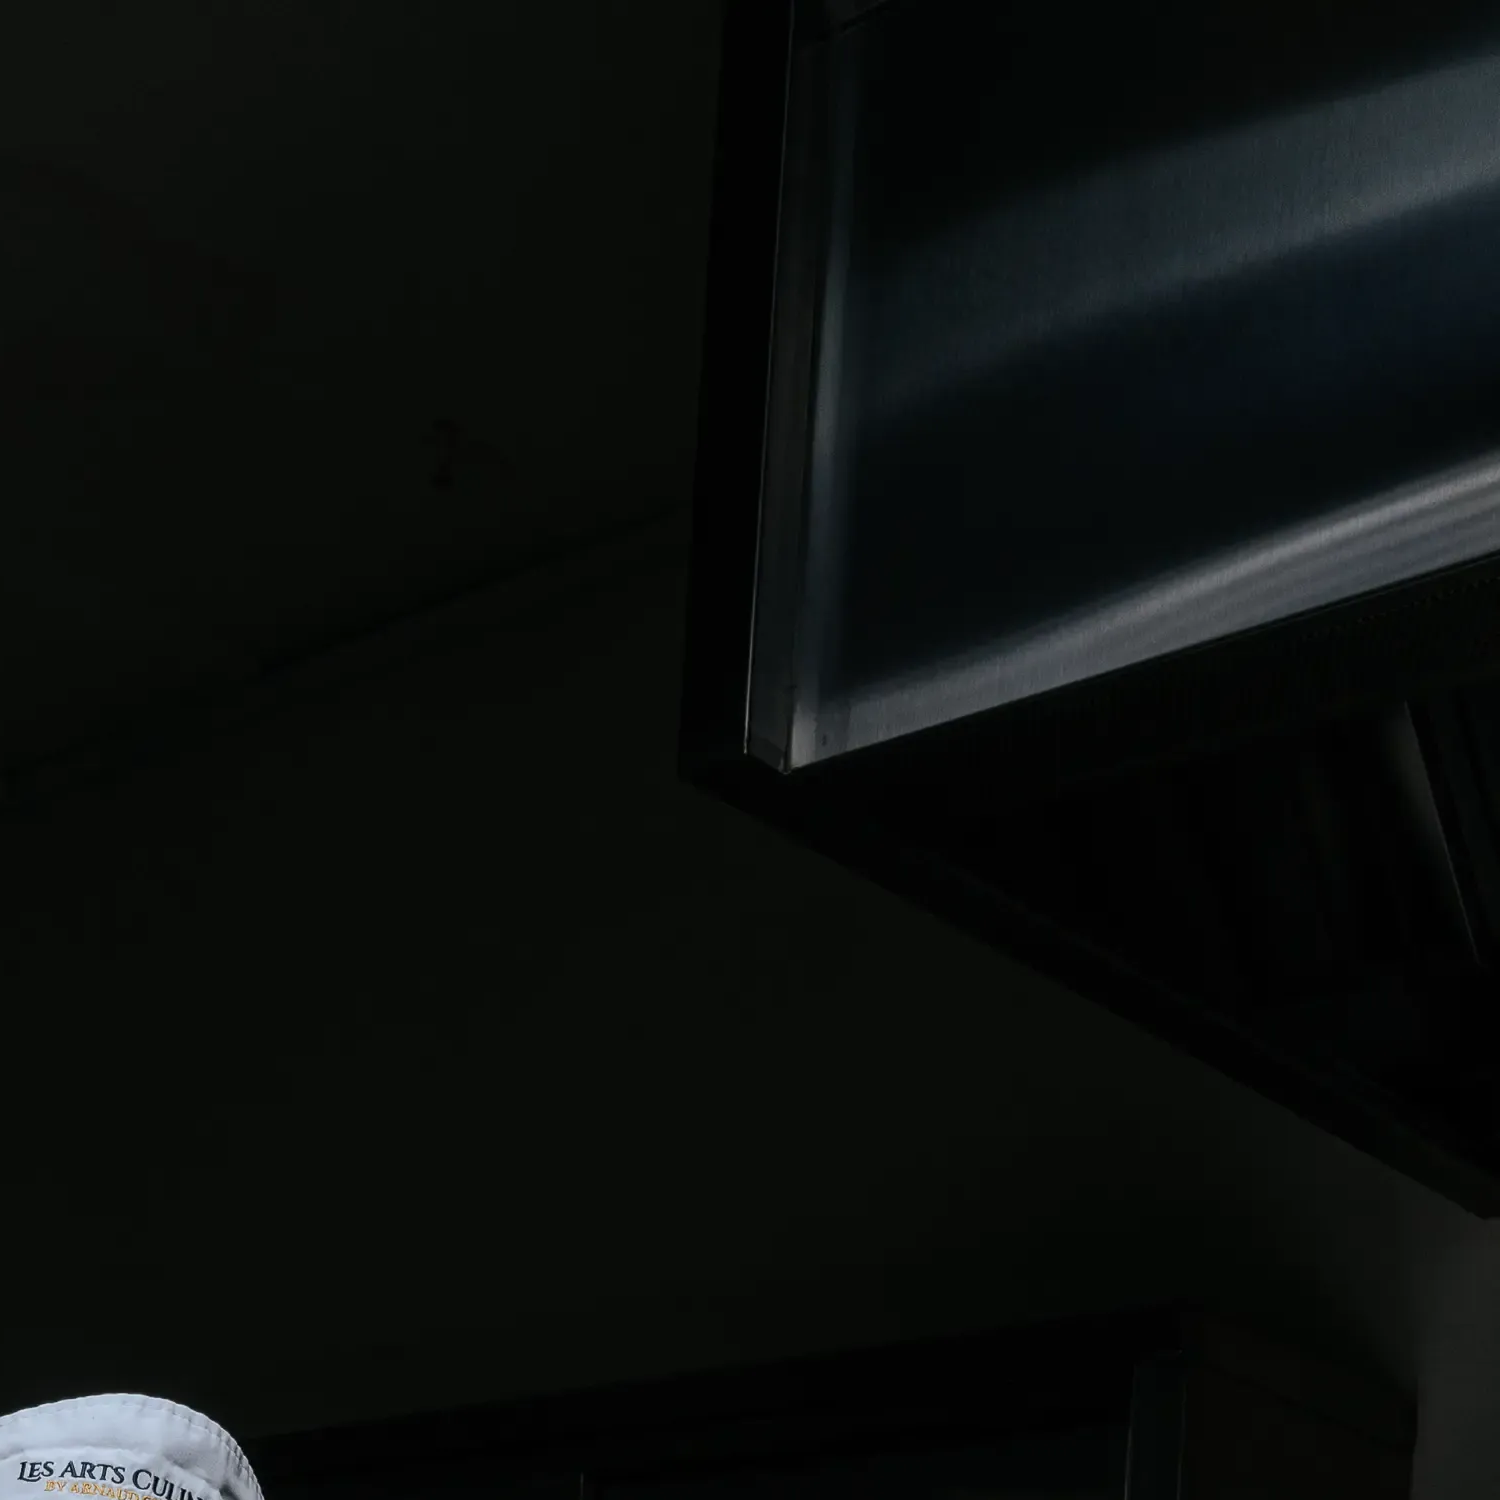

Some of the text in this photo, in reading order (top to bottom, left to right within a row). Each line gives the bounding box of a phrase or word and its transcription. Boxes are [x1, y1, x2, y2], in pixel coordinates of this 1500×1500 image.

[17, 1461, 54, 1482] LES
[59, 1461, 125, 1484] ARTS
[44, 1480, 67, 1492] BY
